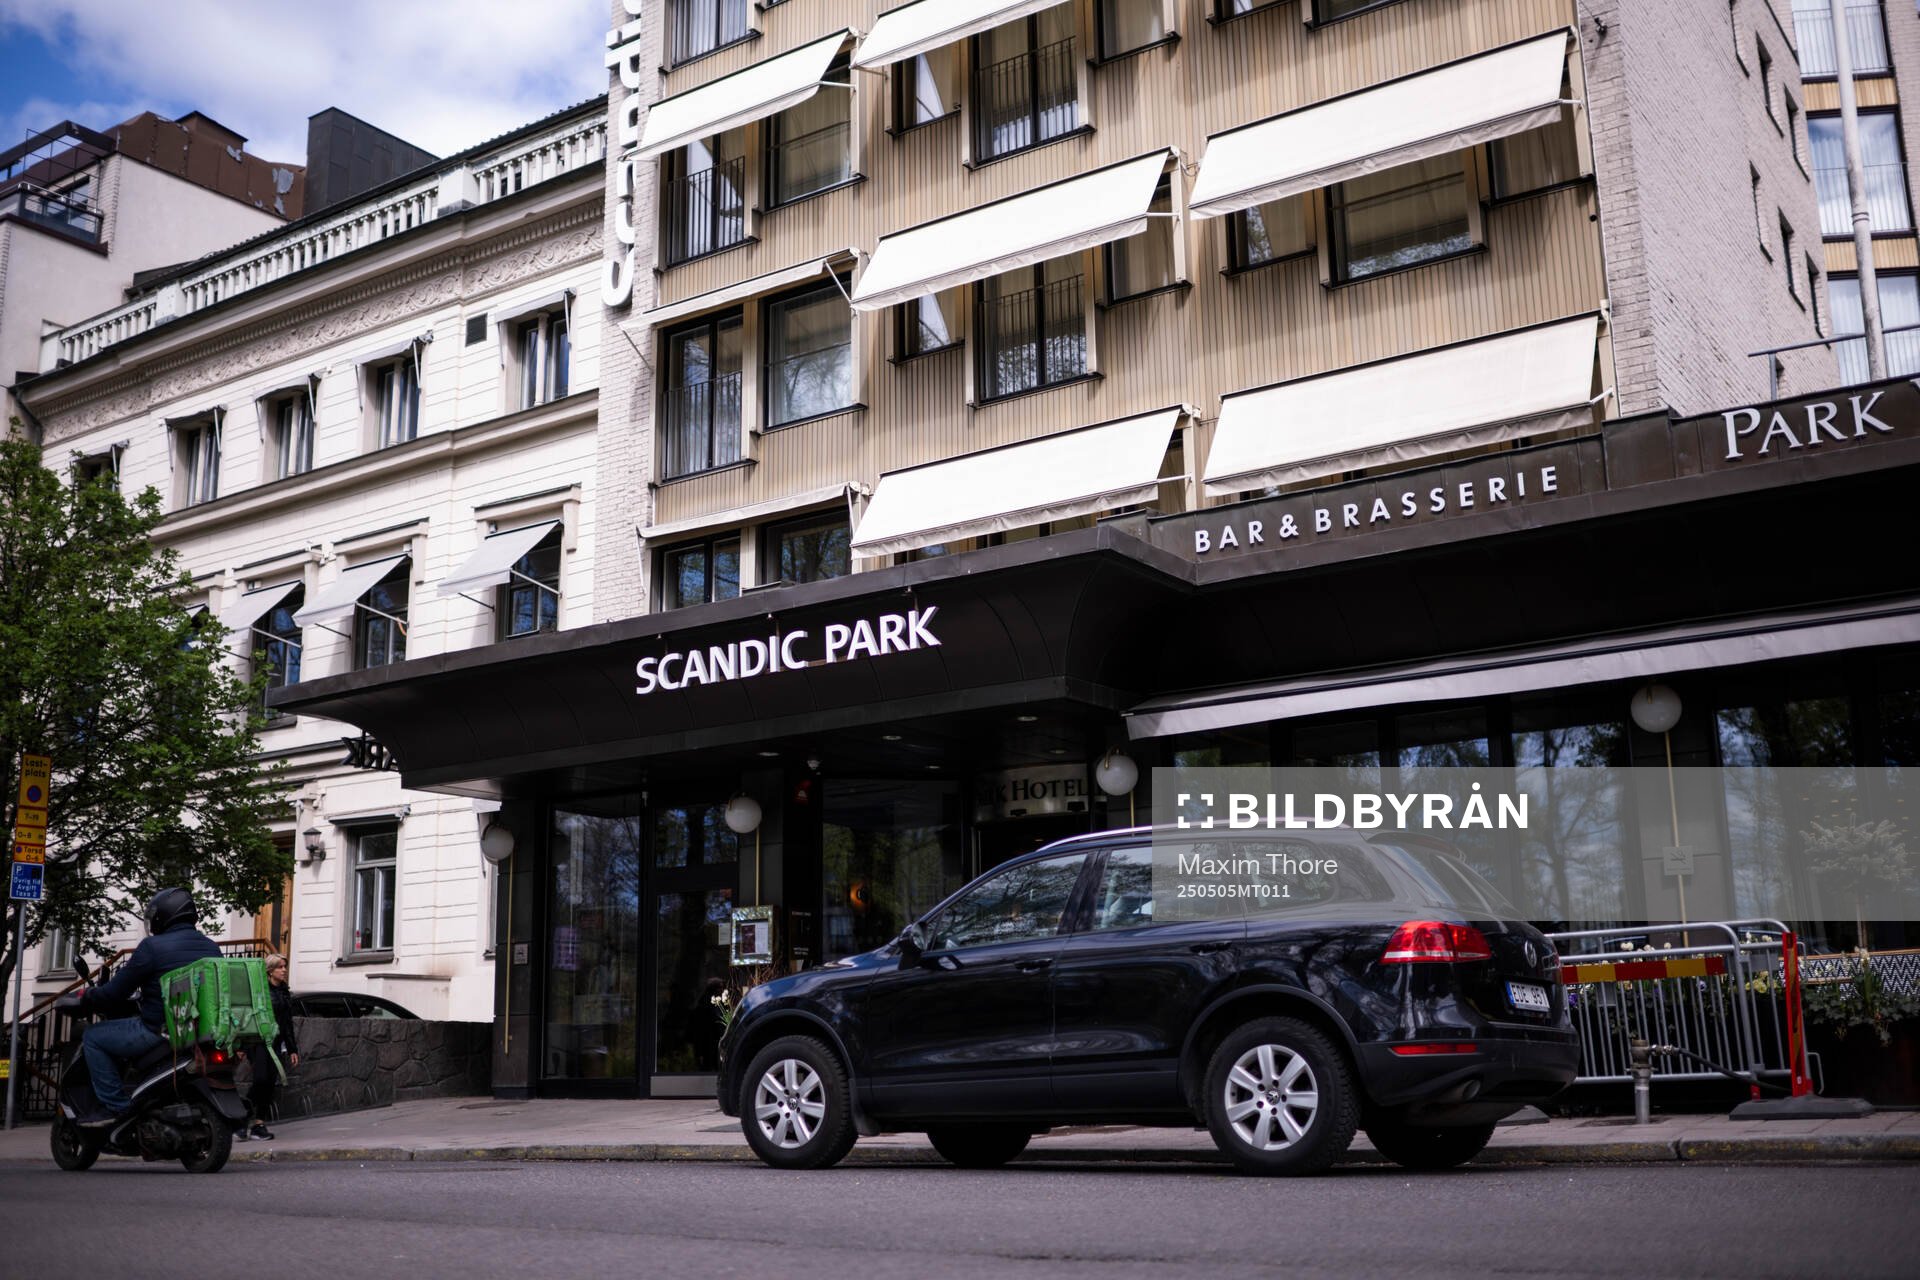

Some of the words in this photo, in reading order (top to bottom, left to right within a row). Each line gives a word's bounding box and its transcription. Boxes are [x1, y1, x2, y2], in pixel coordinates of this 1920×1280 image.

[1721, 391, 1895, 459] PARK
[1195, 520, 1264, 553] BAR
[1279, 514, 1299, 539] &
[1314, 466, 1558, 533] BRASSERIE
[636, 630, 809, 695] SCANDIC
[825, 606, 942, 663] PARK
[25, 768, 46, 778] plats
[1011, 778, 1089, 800] HOTEL
